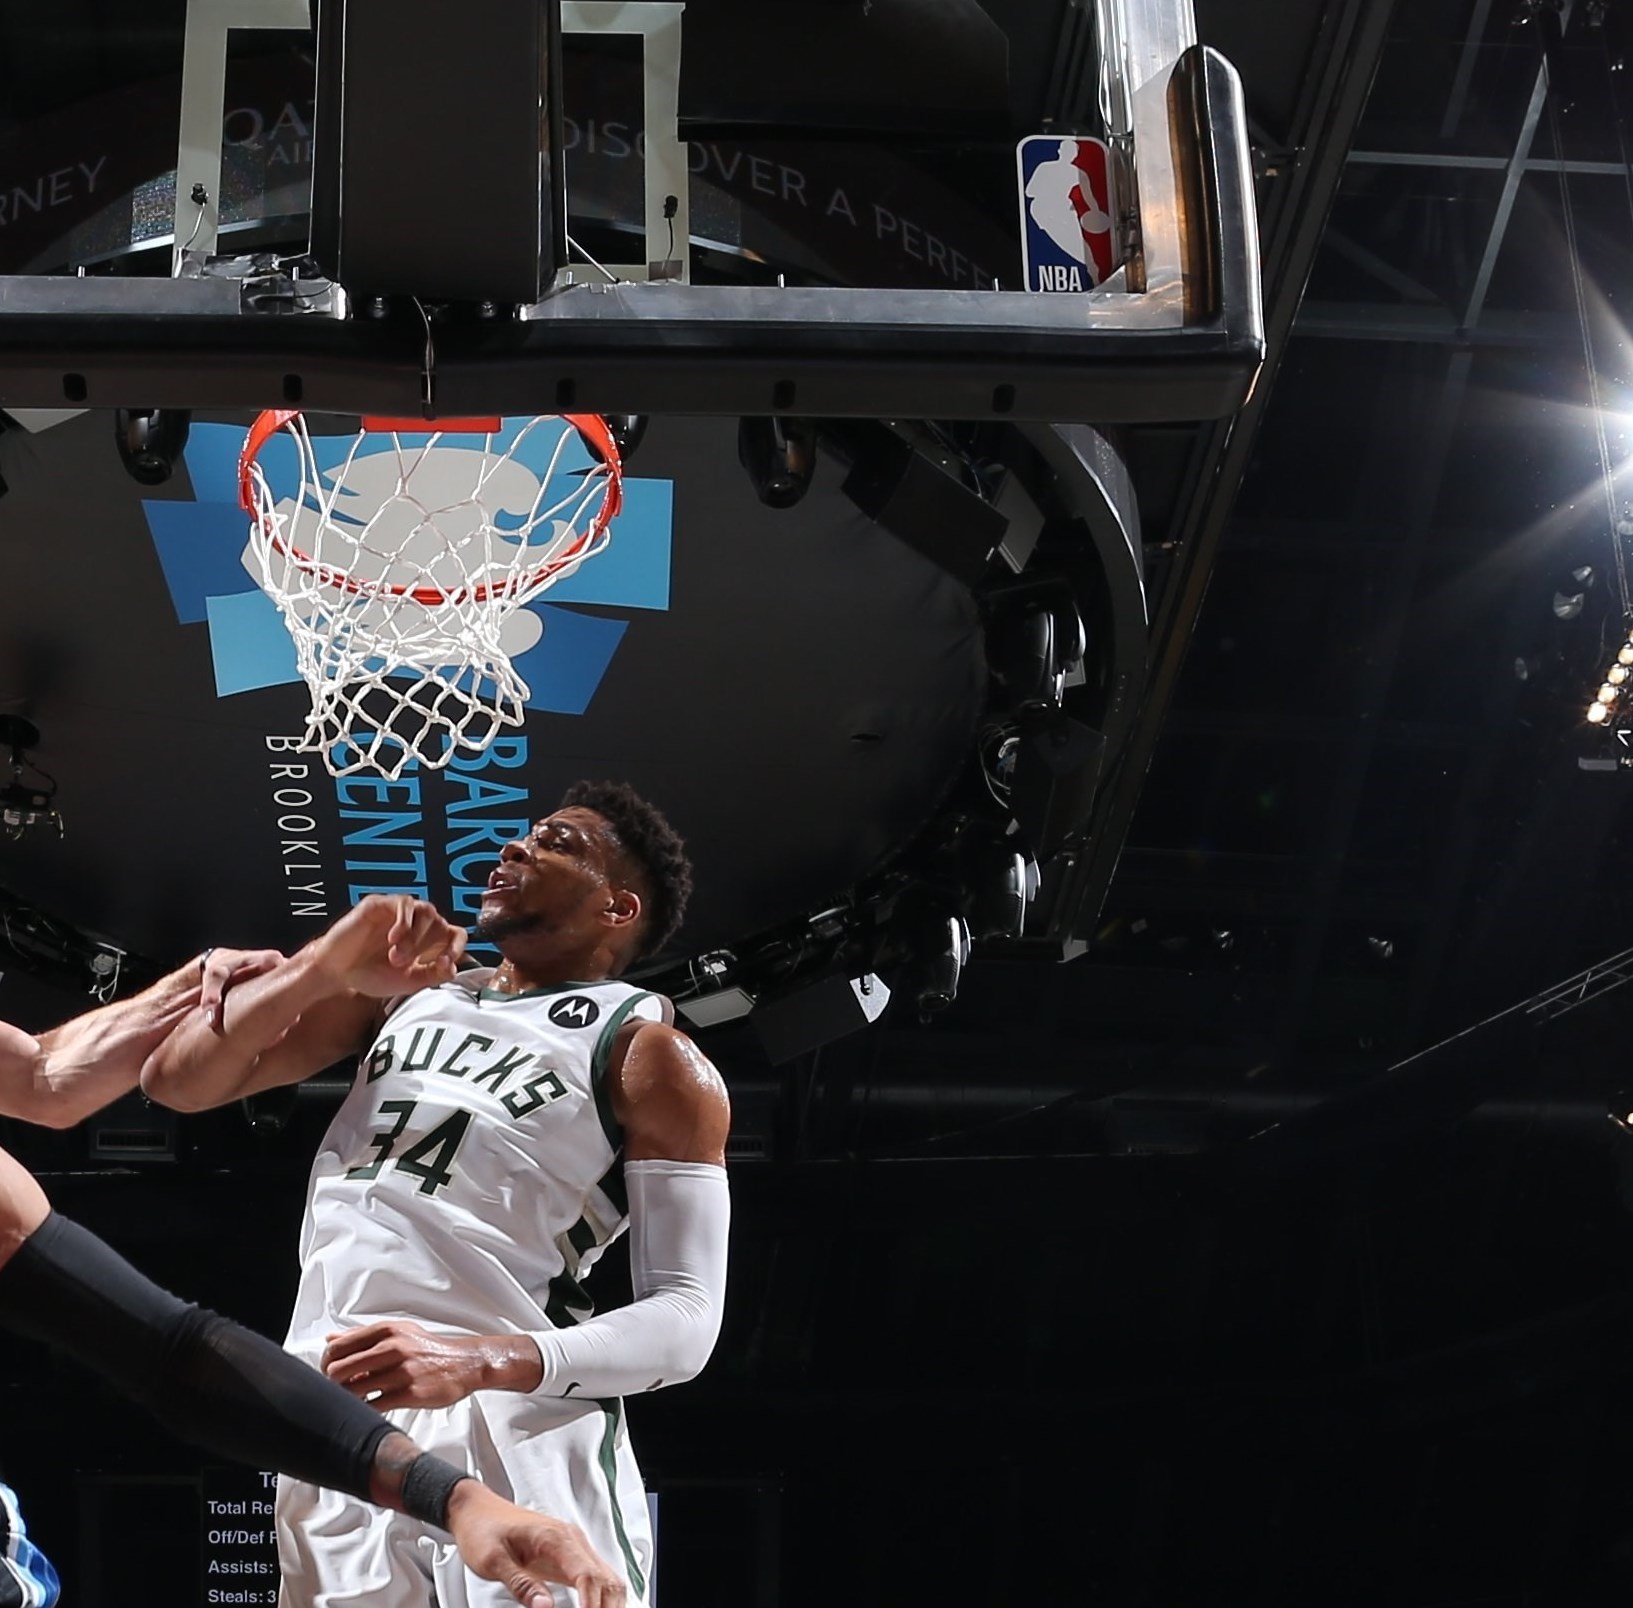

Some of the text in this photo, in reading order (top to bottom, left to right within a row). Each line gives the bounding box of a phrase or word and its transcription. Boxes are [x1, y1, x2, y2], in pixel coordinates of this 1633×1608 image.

[563, 117, 1004, 290] DISOVER A PERFE
[1038, 265, 1083, 292] NBA
[266, 735, 328, 916] BROOKLYN
[330, 732, 429, 907] CENTE
[366, 1028, 570, 1120] BUCKS
[345, 1100, 473, 1196] 34
[208, 1501, 246, 1515] Total
[208, 1531, 264, 1544] Off/Def
[208, 1560, 273, 1574] Assists:
[208, 1590, 263, 1603] Steals:
